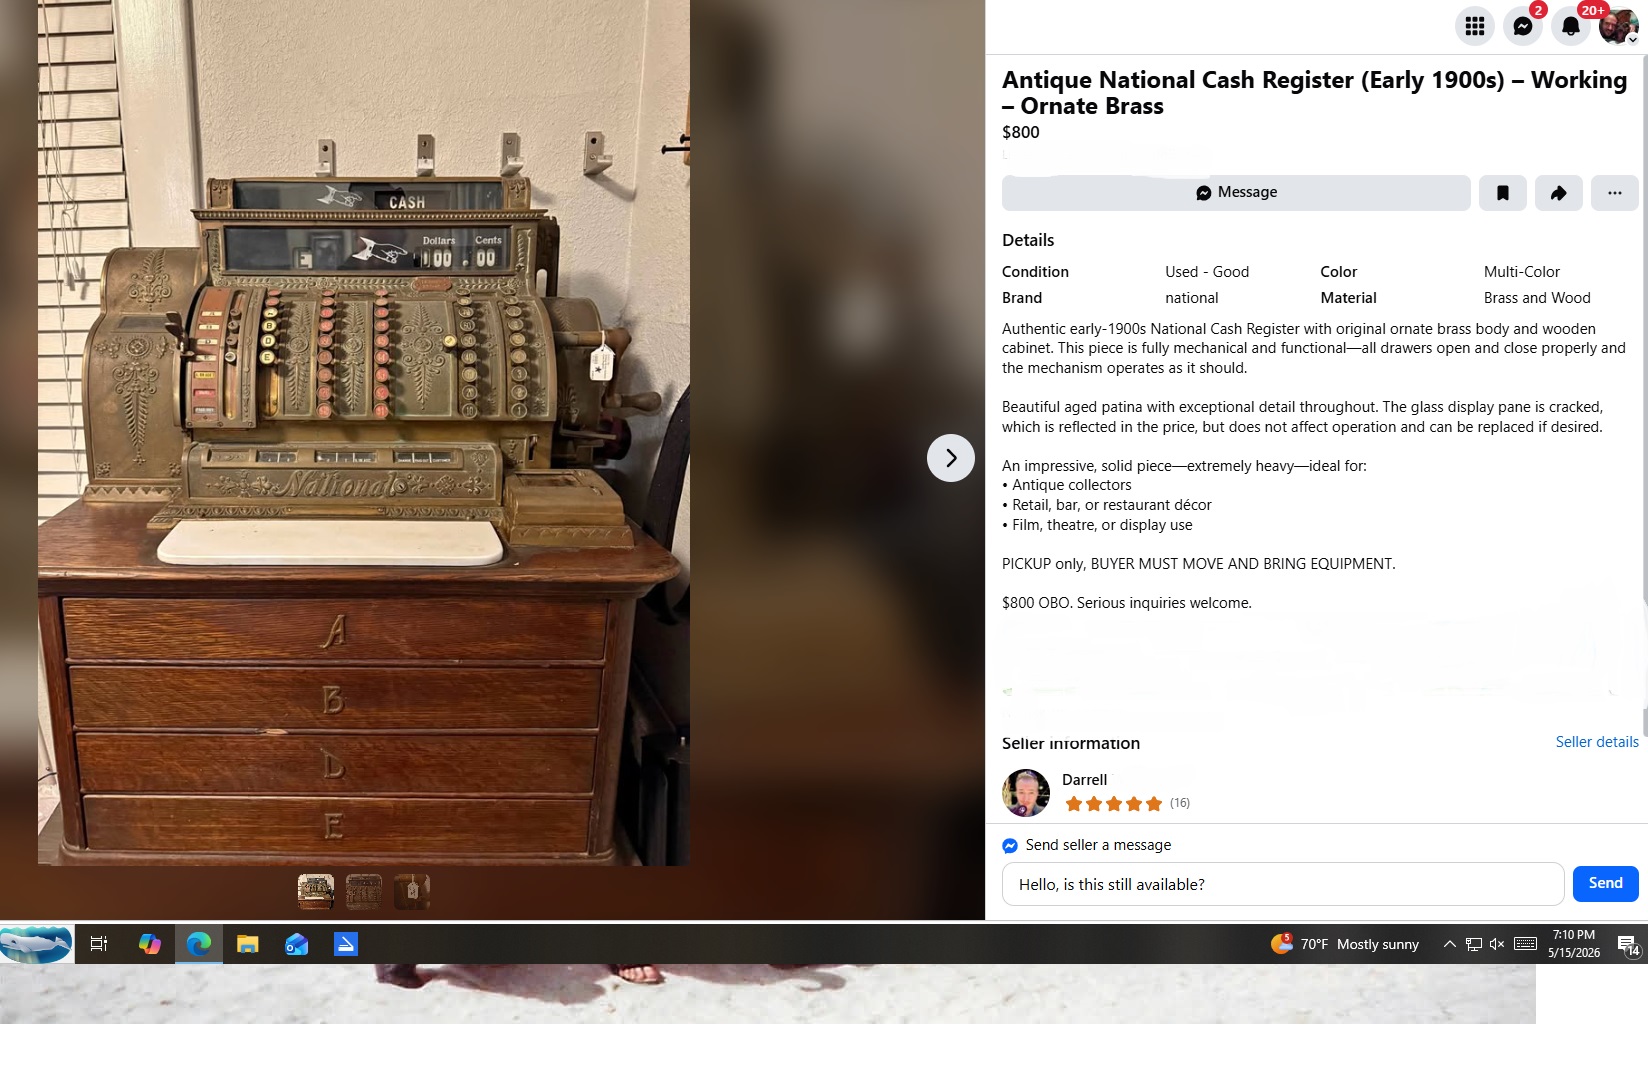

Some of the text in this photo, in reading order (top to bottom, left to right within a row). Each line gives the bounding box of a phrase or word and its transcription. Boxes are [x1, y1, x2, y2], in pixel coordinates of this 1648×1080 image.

[1534, 5, 1543, 16] 2
[1581, 5, 1606, 16] 20+
[1001, 69, 1628, 95] Antique National Cash Register (Early 1900s) Working
[1020, 96, 1165, 115] Ornate Brass
[1002, 124, 1040, 141] $800
[1218, 185, 1278, 201] Message
[389, 196, 426, 209] CASH
[423, 235, 503, 245] Dollars Cents
[1002, 232, 1055, 247] Details
[1001, 265, 1069, 278] Condition
[1165, 265, 1250, 278] Used Good
[1320, 265, 1359, 278] Color
[1484, 265, 1561, 278] Multi-Color
[1002, 291, 1043, 304] Brand
[1165, 291, 1219, 304] national
[1321, 291, 1377, 304] Material
[1484, 291, 1591, 304] Brass and Wood
[1001, 322, 1596, 338] Authentic early-1900s National Cash Register with original ornate brass body and wooden
[1001, 341, 1054, 354] cabinet.
[1057, 341, 1085, 354] This
[1088, 341, 1124, 357] piece
[1127, 341, 1138, 354] is
[1141, 341, 1170, 357] fully
[1173, 341, 1248, 354] mechanical
[1251, 341, 1277, 354] and
[1380, 341, 1433, 354] drawers
[1436, 344, 1471, 357] open
[1474, 341, 1500, 354] and
[1503, 341, 1538, 354] close
[1541, 341, 1598, 357] properly
[1600, 341, 1626, 354] and
[1001, 361, 1248, 377] the mechanism operates as it should.
[1002, 400, 1603, 416] Beautiful aged patina with exceptional detail throughout. The glass display pane is cracked,
[1001, 459, 1021, 472] An
[1024, 459, 1097, 475] impressive,
[1101, 459, 1133, 472] solid
[1344, 459, 1367, 472] for:
[273, 470, 399, 498] National
[1011, 478, 1132, 494] Antique collectors
[1012, 498, 1213, 513] Retail, bar, or restaurant décor
[1012, 518, 1193, 534] Film, theatre, or display use
[1002, 557, 1396, 573] PICKUP only, BUYER MUST MOVE AND BRING EQUIPMENT.
[1002, 595, 1252, 612] $800 OBO. Serious inquiries welcome.
[319, 614, 346, 649] A
[322, 685, 345, 714] B
[1002, 736, 1141, 750] Seller information
[1556, 735, 1640, 748] Seller details
[320, 747, 346, 780] D
[1062, 773, 1108, 786] Darrell
[1170, 797, 1191, 810] (16)
[324, 812, 344, 839] E
[1026, 838, 1172, 854] Send seller a message
[1019, 877, 1205, 893] Hello, is this still available?
[1589, 876, 1623, 889] Send
[1284, 933, 1290, 942] 5
[1552, 929, 1596, 940] 7:10 PM
[1300, 938, 1329, 950] 70°F
[1337, 938, 1420, 953] Mostly sunny
[1627, 945, 1641, 956] 14
[1548, 947, 1601, 959] 5/15/2026
